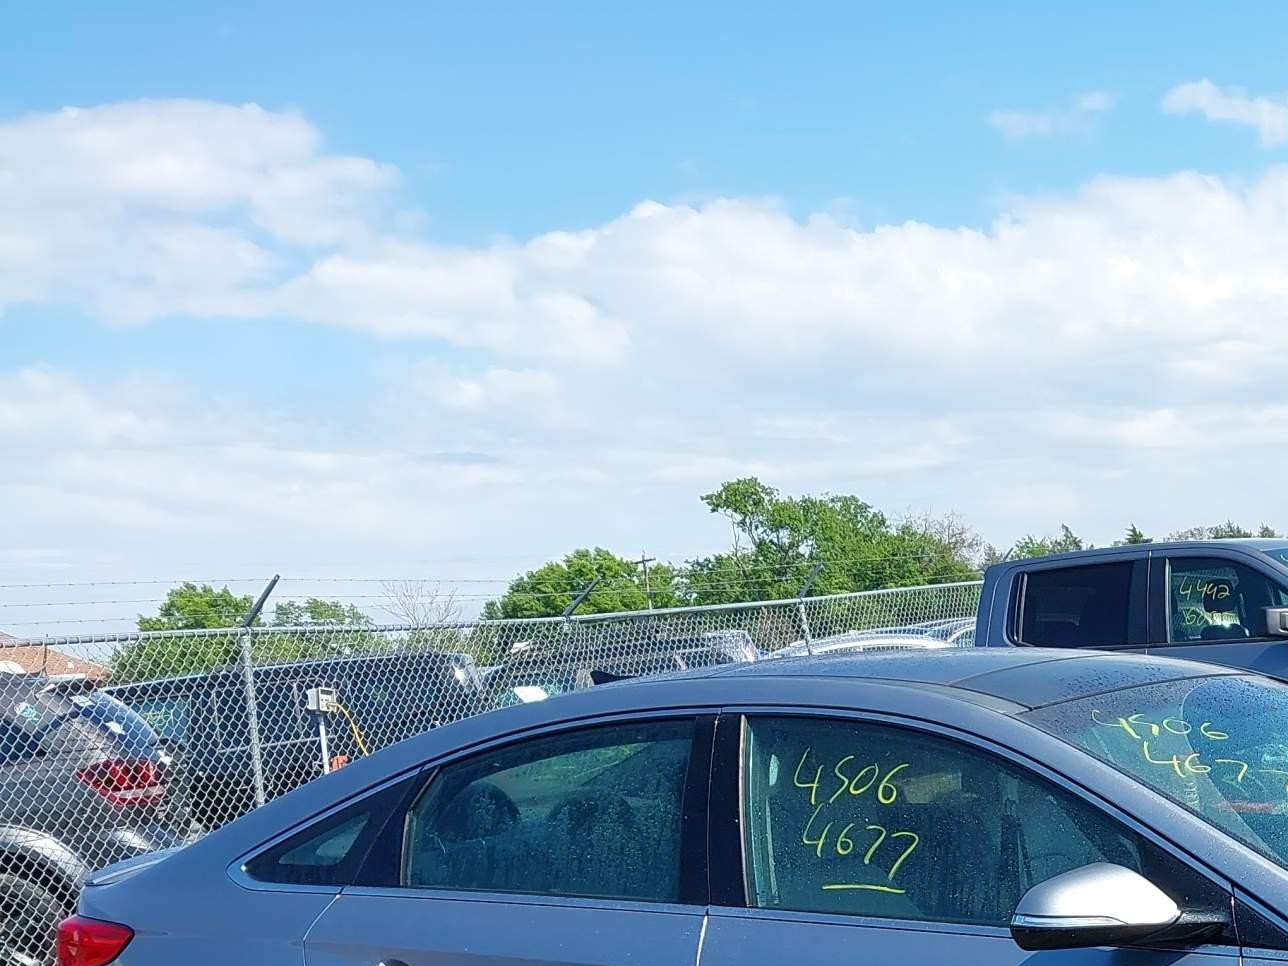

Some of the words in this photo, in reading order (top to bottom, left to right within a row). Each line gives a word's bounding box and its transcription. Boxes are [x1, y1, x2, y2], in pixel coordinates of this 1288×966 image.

[1180, 575, 1231, 601] 4492
[1091, 709, 1230, 740] 4506
[793, 746, 910, 805] 4506
[802, 802, 920, 881] 4677
